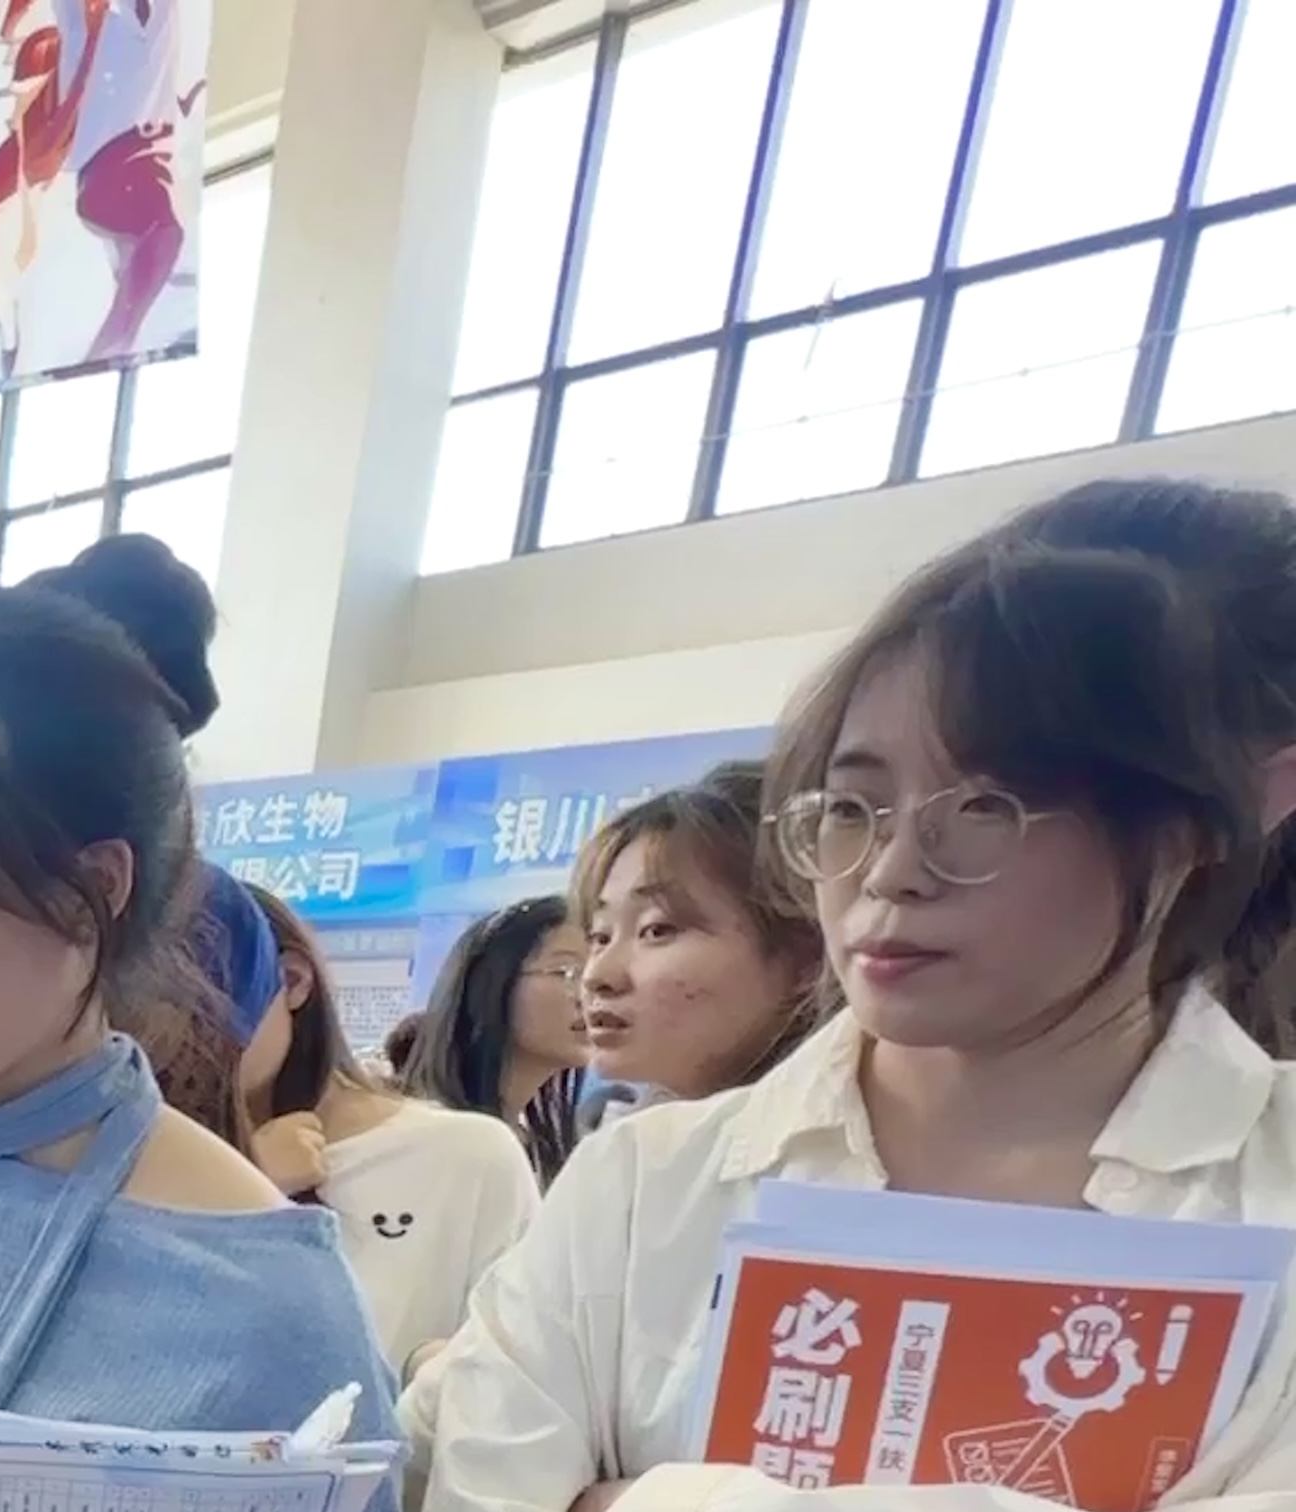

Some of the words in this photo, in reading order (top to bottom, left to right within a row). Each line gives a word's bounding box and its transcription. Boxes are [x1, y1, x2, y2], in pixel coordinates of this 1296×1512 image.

[493, 787, 653, 863] 银川
[877, 1323, 936, 1473] 宁夏三支一扶
